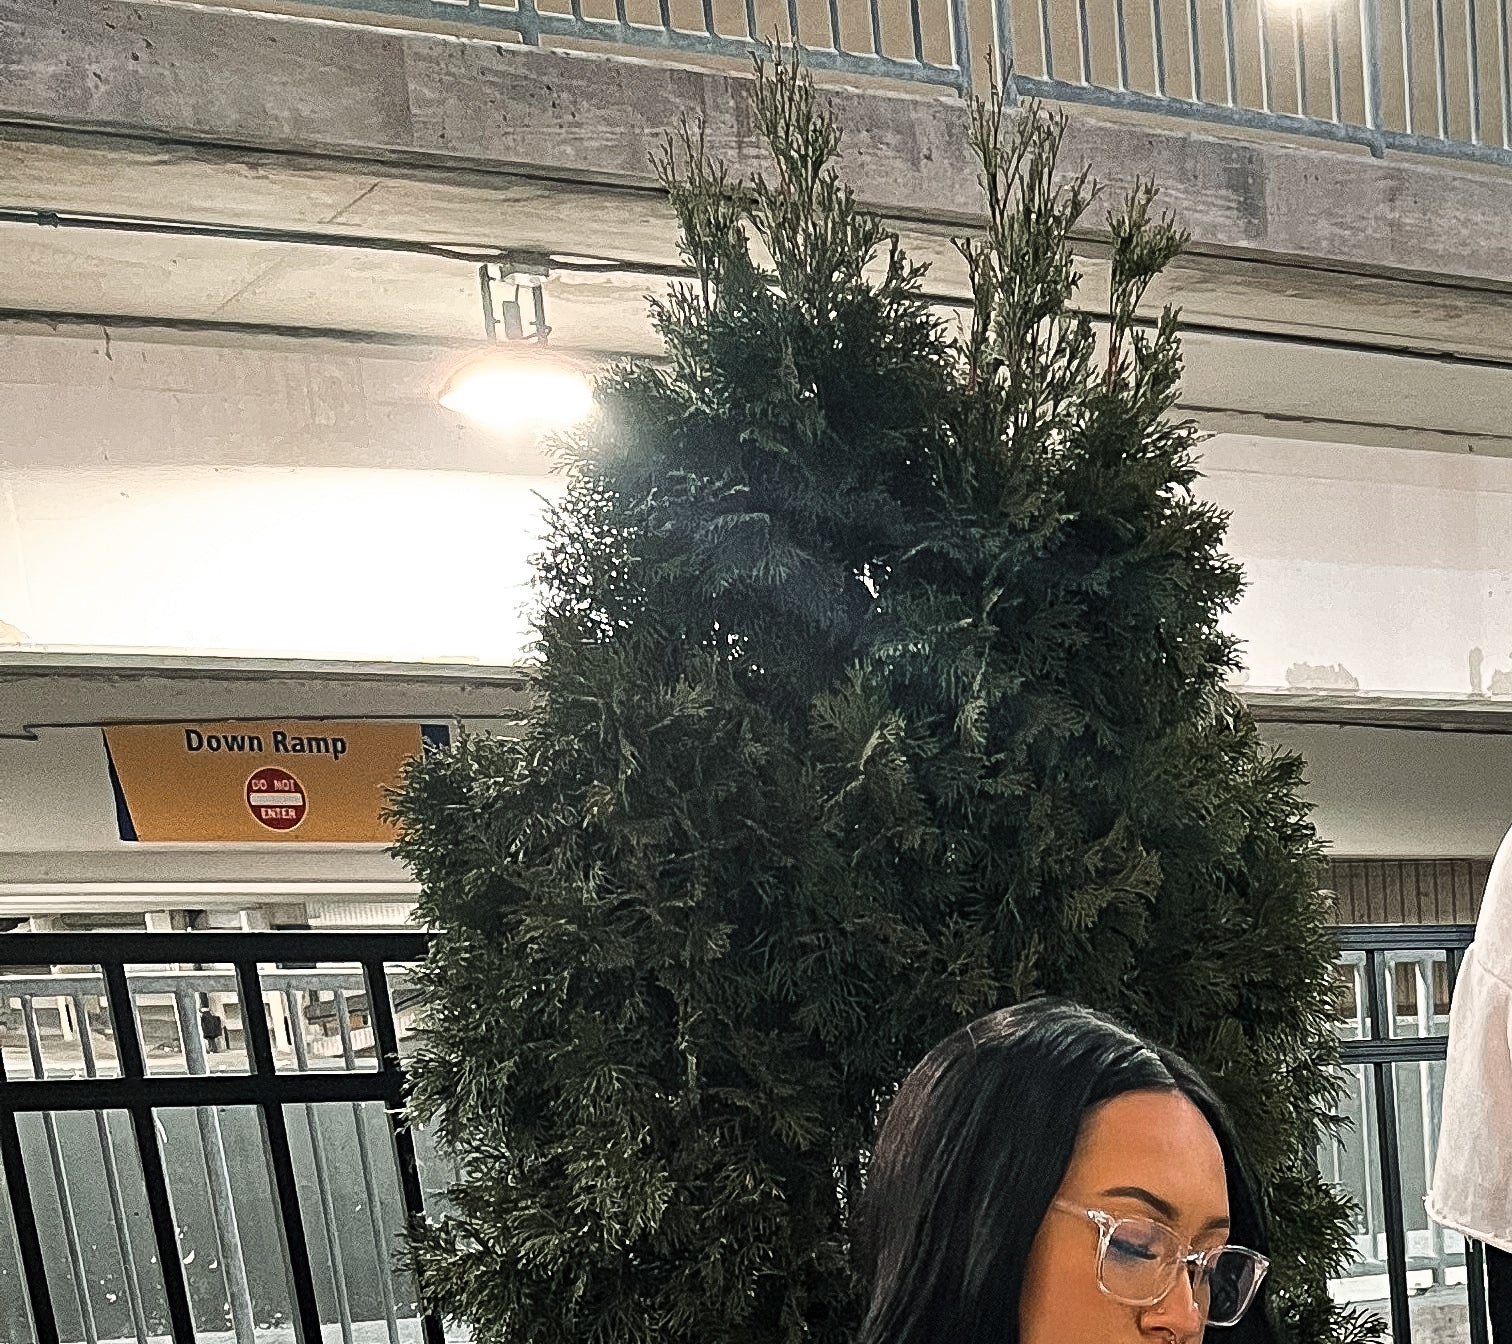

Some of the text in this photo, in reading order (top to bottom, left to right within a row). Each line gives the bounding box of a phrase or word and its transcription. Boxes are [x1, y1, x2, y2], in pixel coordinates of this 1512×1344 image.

[184, 728, 347, 761] Down Ramp
[251, 779, 295, 791] DO NOT
[260, 807, 296, 819] ENTER
